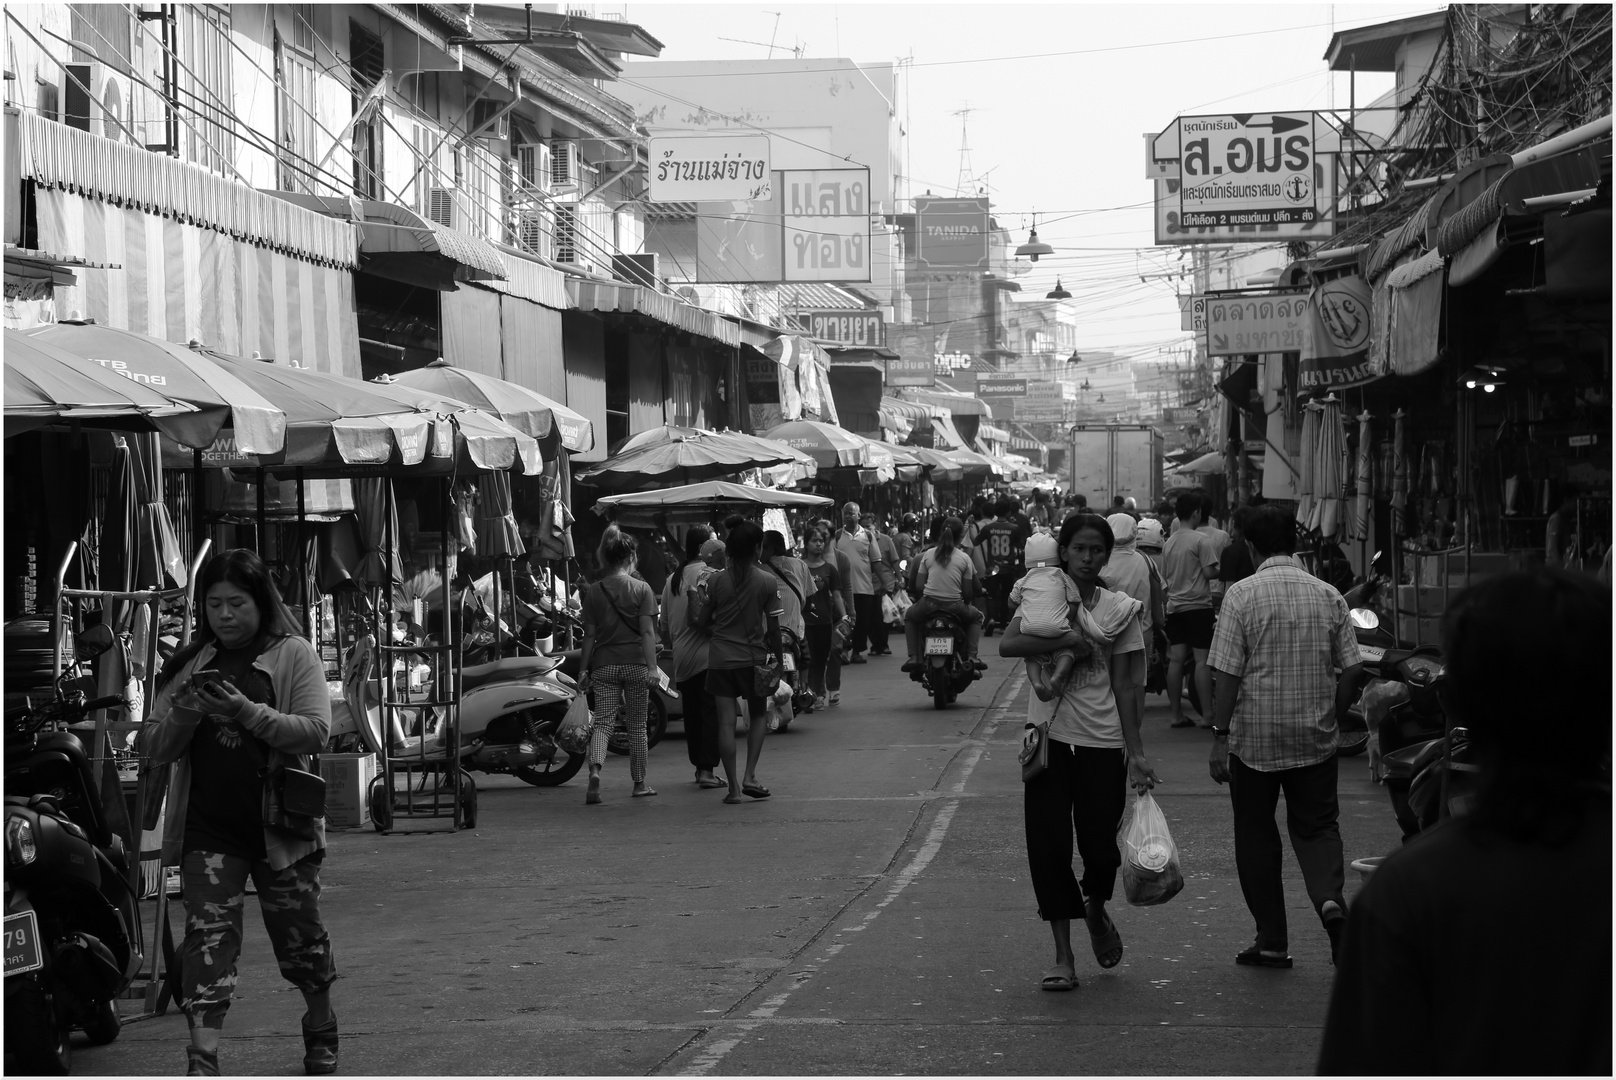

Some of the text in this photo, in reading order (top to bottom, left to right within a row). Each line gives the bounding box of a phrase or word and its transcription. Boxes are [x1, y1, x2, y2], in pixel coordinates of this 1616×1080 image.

[1184, 120, 1238, 134] ชุดนักเรียน
[657, 150, 765, 182] ร้านแม่จ่าง
[1184, 135, 1310, 175] ส.อมร
[792, 181, 863, 219] แสง
[1183, 181, 1281, 204] และชุดนักเรียนตราสมอ
[1183, 213, 1216, 226] มีให้เลือก
[1220, 215, 1227, 224] 2
[1230, 211, 1270, 224] แบรนด์เนม
[1273, 211, 1291, 222] ปลีก
[1302, 209, 1314, 221] ส่ง
[926, 225, 979, 236] TANIDA
[793, 232, 863, 269] ทอง
[1212, 298, 1308, 323] ตลาดสด
[814, 316, 880, 346] ขายยา
[88, 358, 127, 370] TB
[980, 383, 1025, 393] Panasonic
[991, 534, 1011, 557] 88
